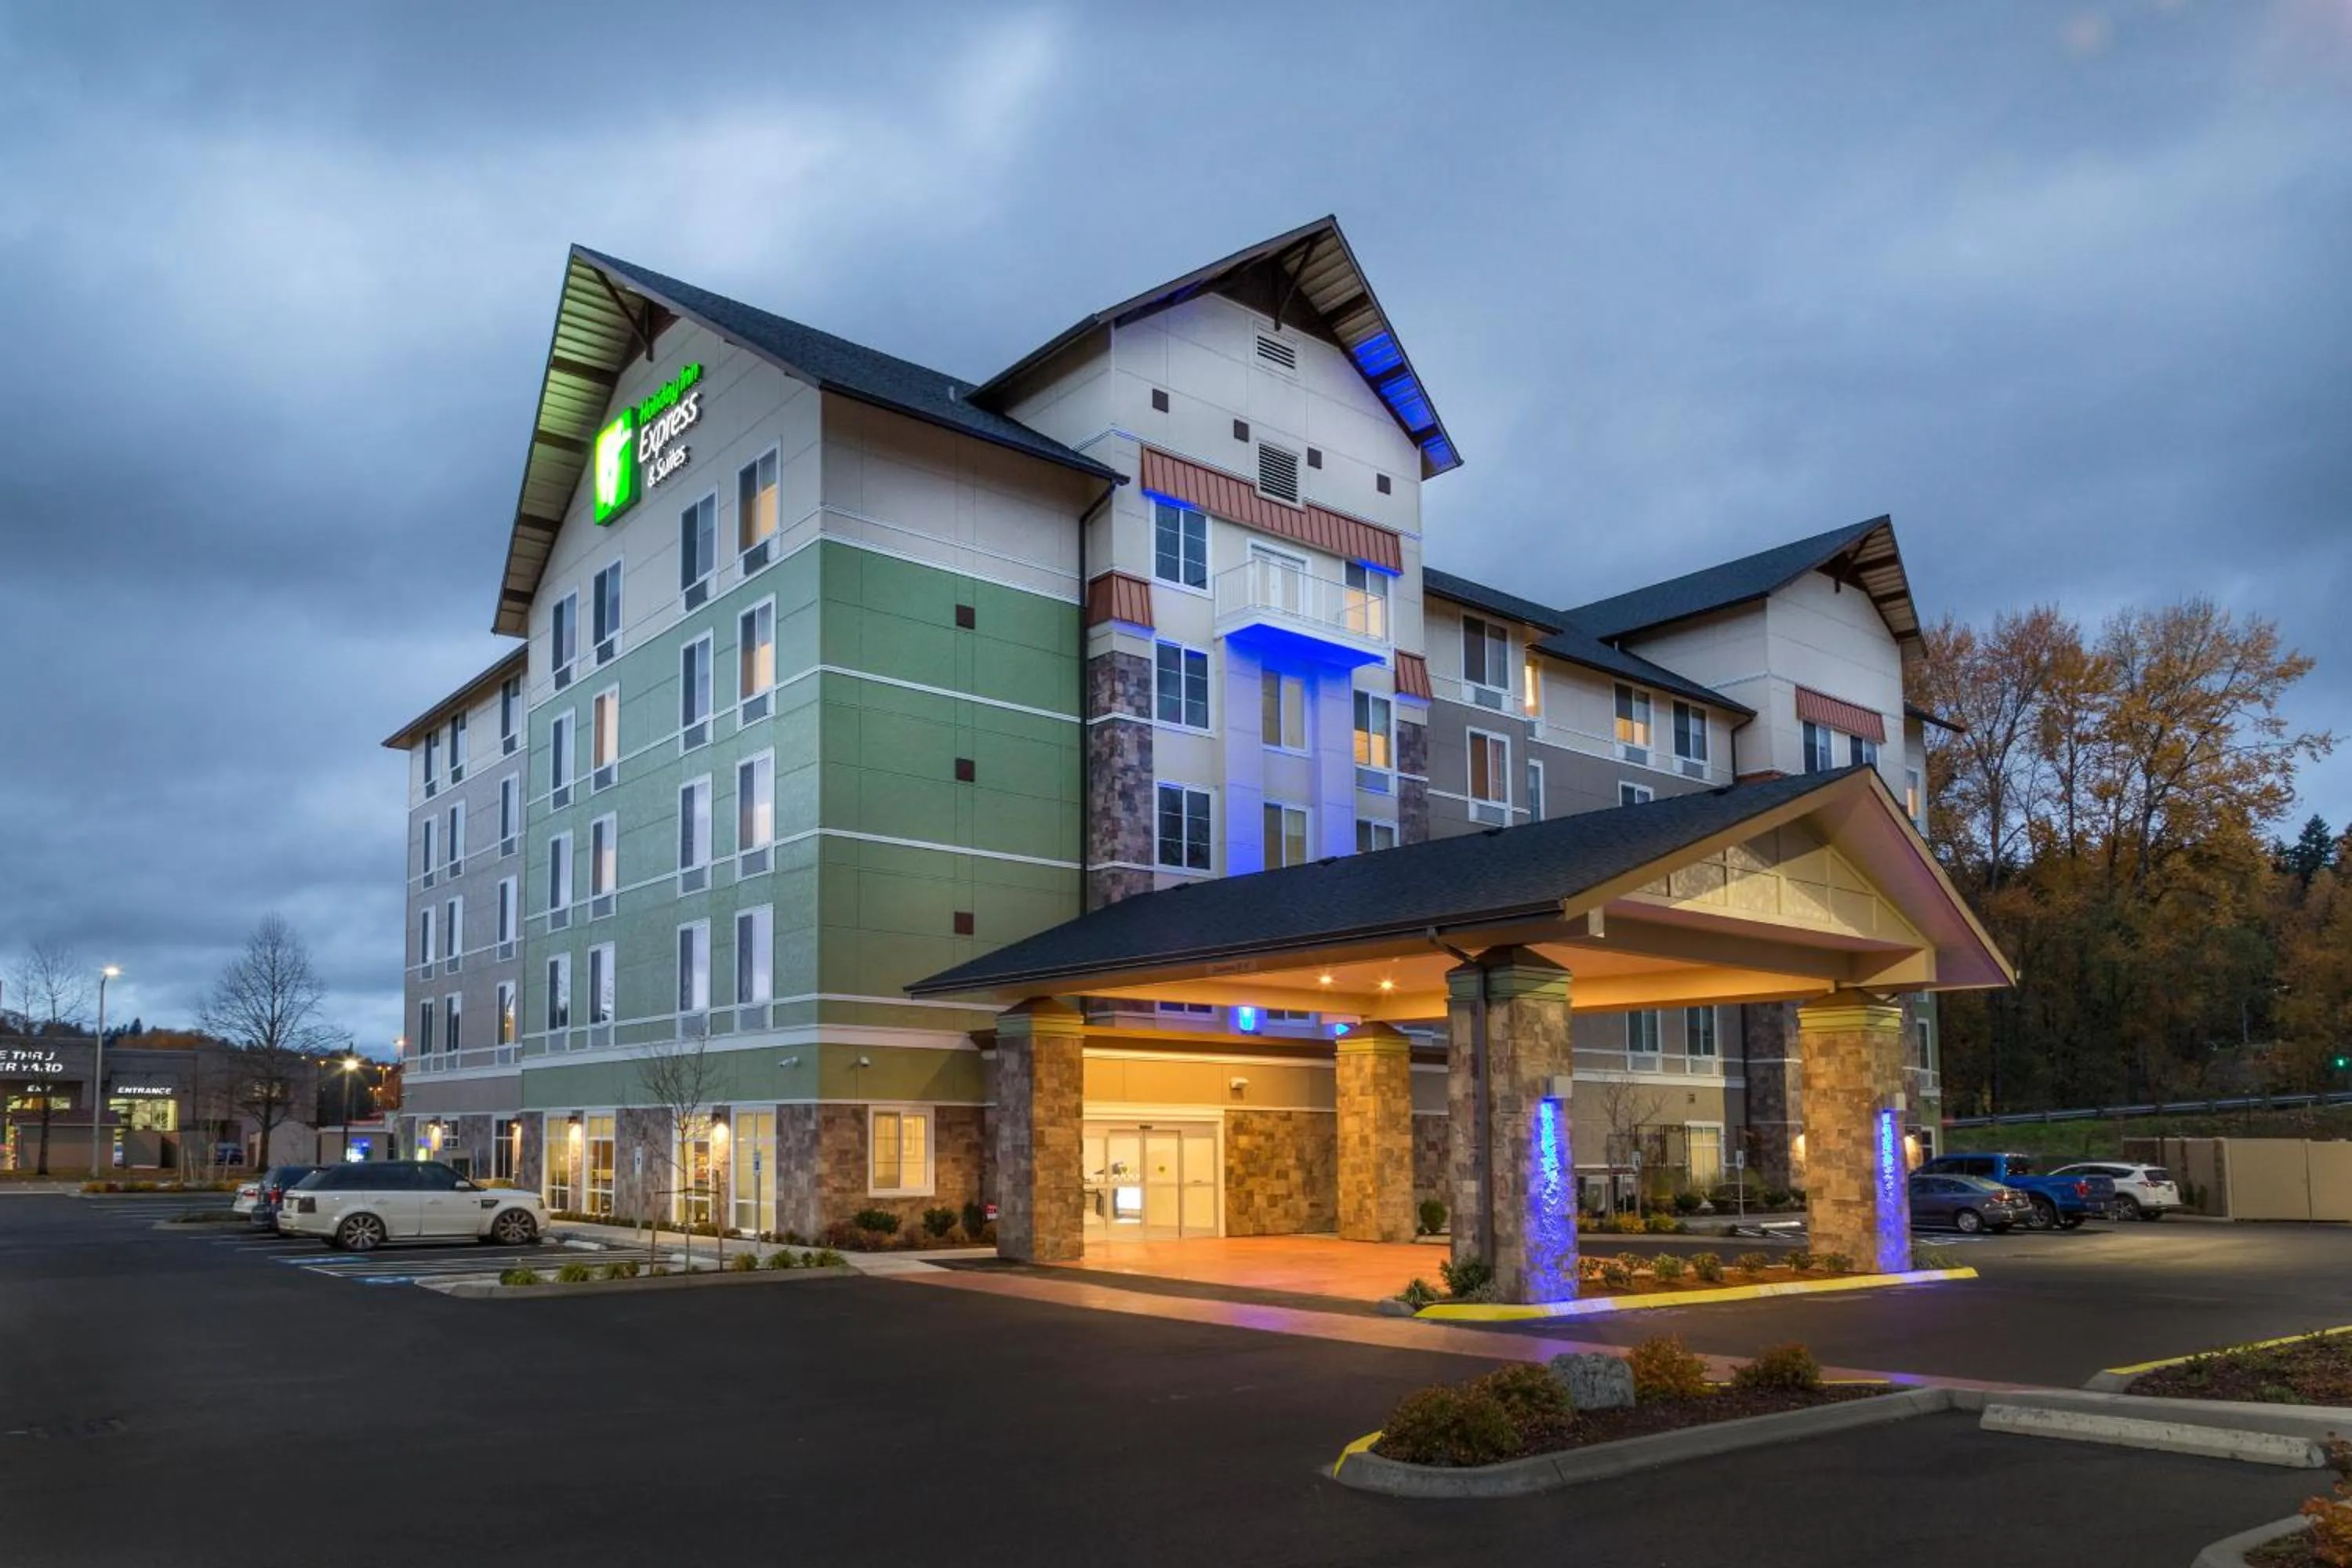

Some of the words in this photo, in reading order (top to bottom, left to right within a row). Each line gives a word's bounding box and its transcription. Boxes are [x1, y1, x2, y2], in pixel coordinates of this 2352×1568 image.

[639, 392, 698, 463] Express
[648, 464, 655, 487] &
[656, 445, 686, 481] Suites
[118, 1086, 172, 1095] ENTRANCE
